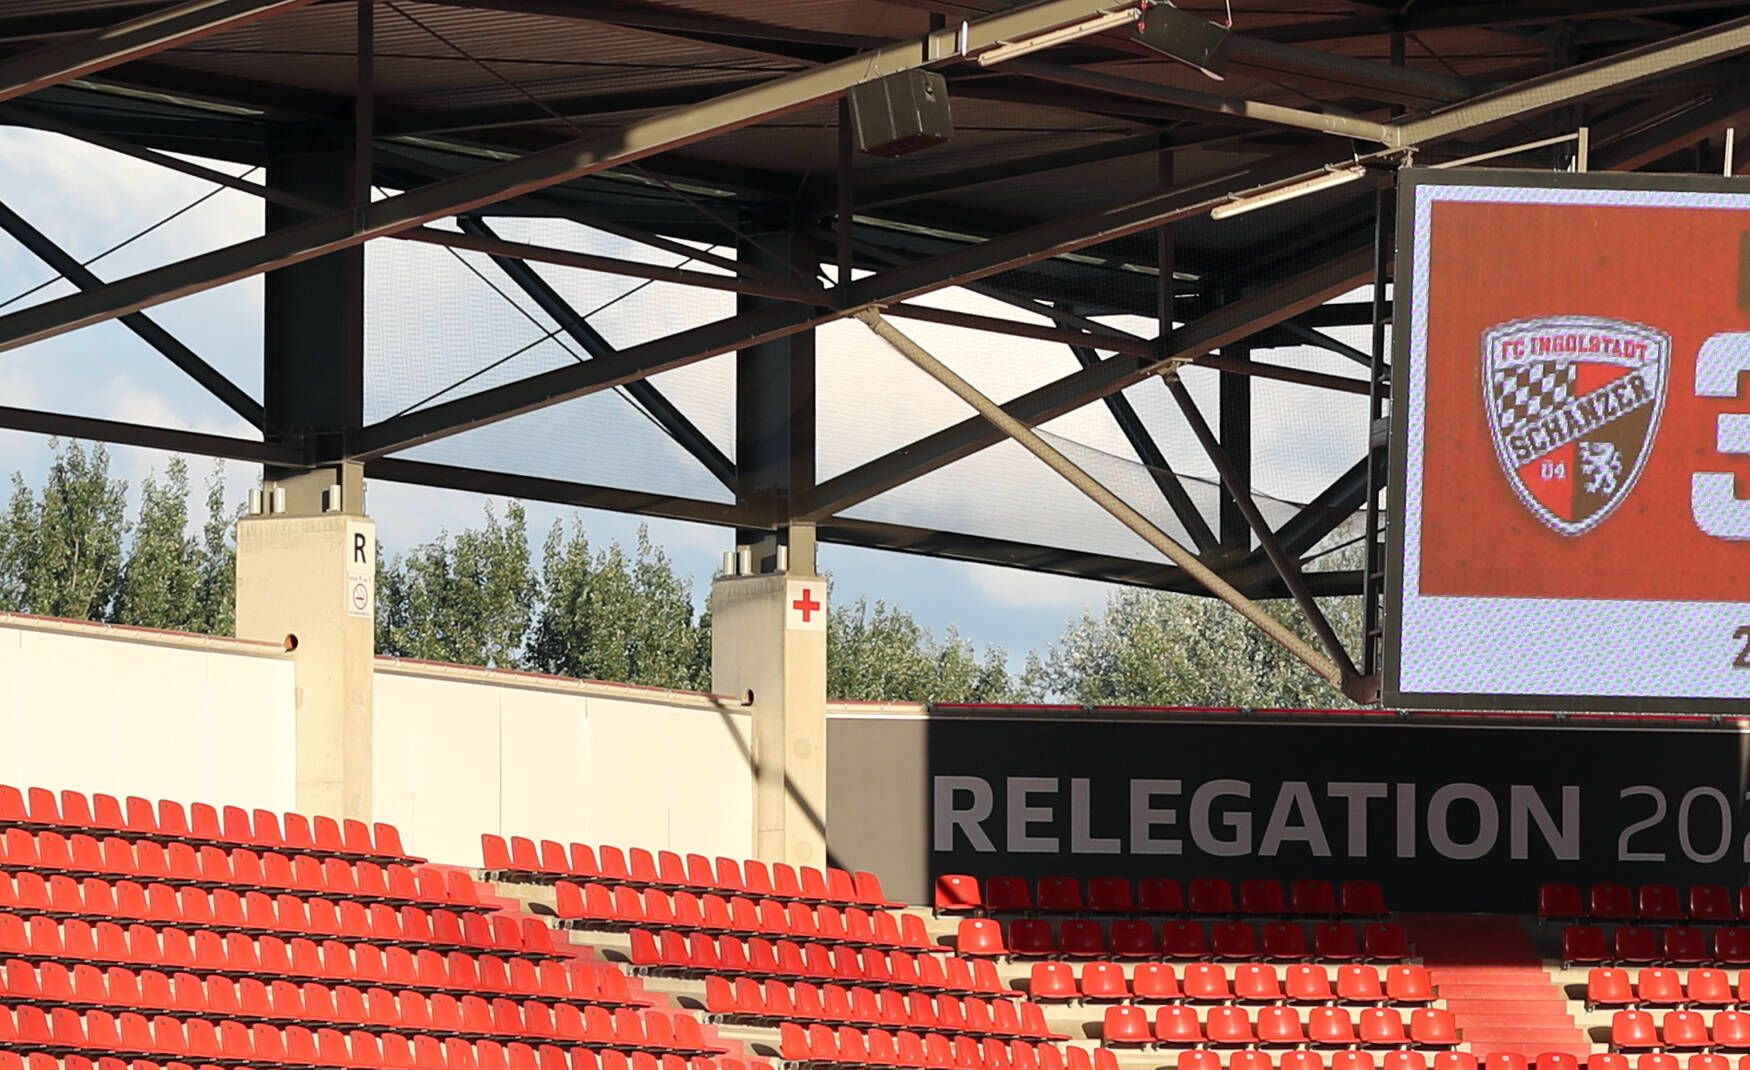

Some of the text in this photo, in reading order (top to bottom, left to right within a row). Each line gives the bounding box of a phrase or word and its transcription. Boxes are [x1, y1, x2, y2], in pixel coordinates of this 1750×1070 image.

[1502, 335, 1649, 361] FC INGOLSTADT
[1510, 375, 1647, 460] SCHANZER
[354, 532, 367, 564] R
[933, 775, 1580, 861] RELEGATION
